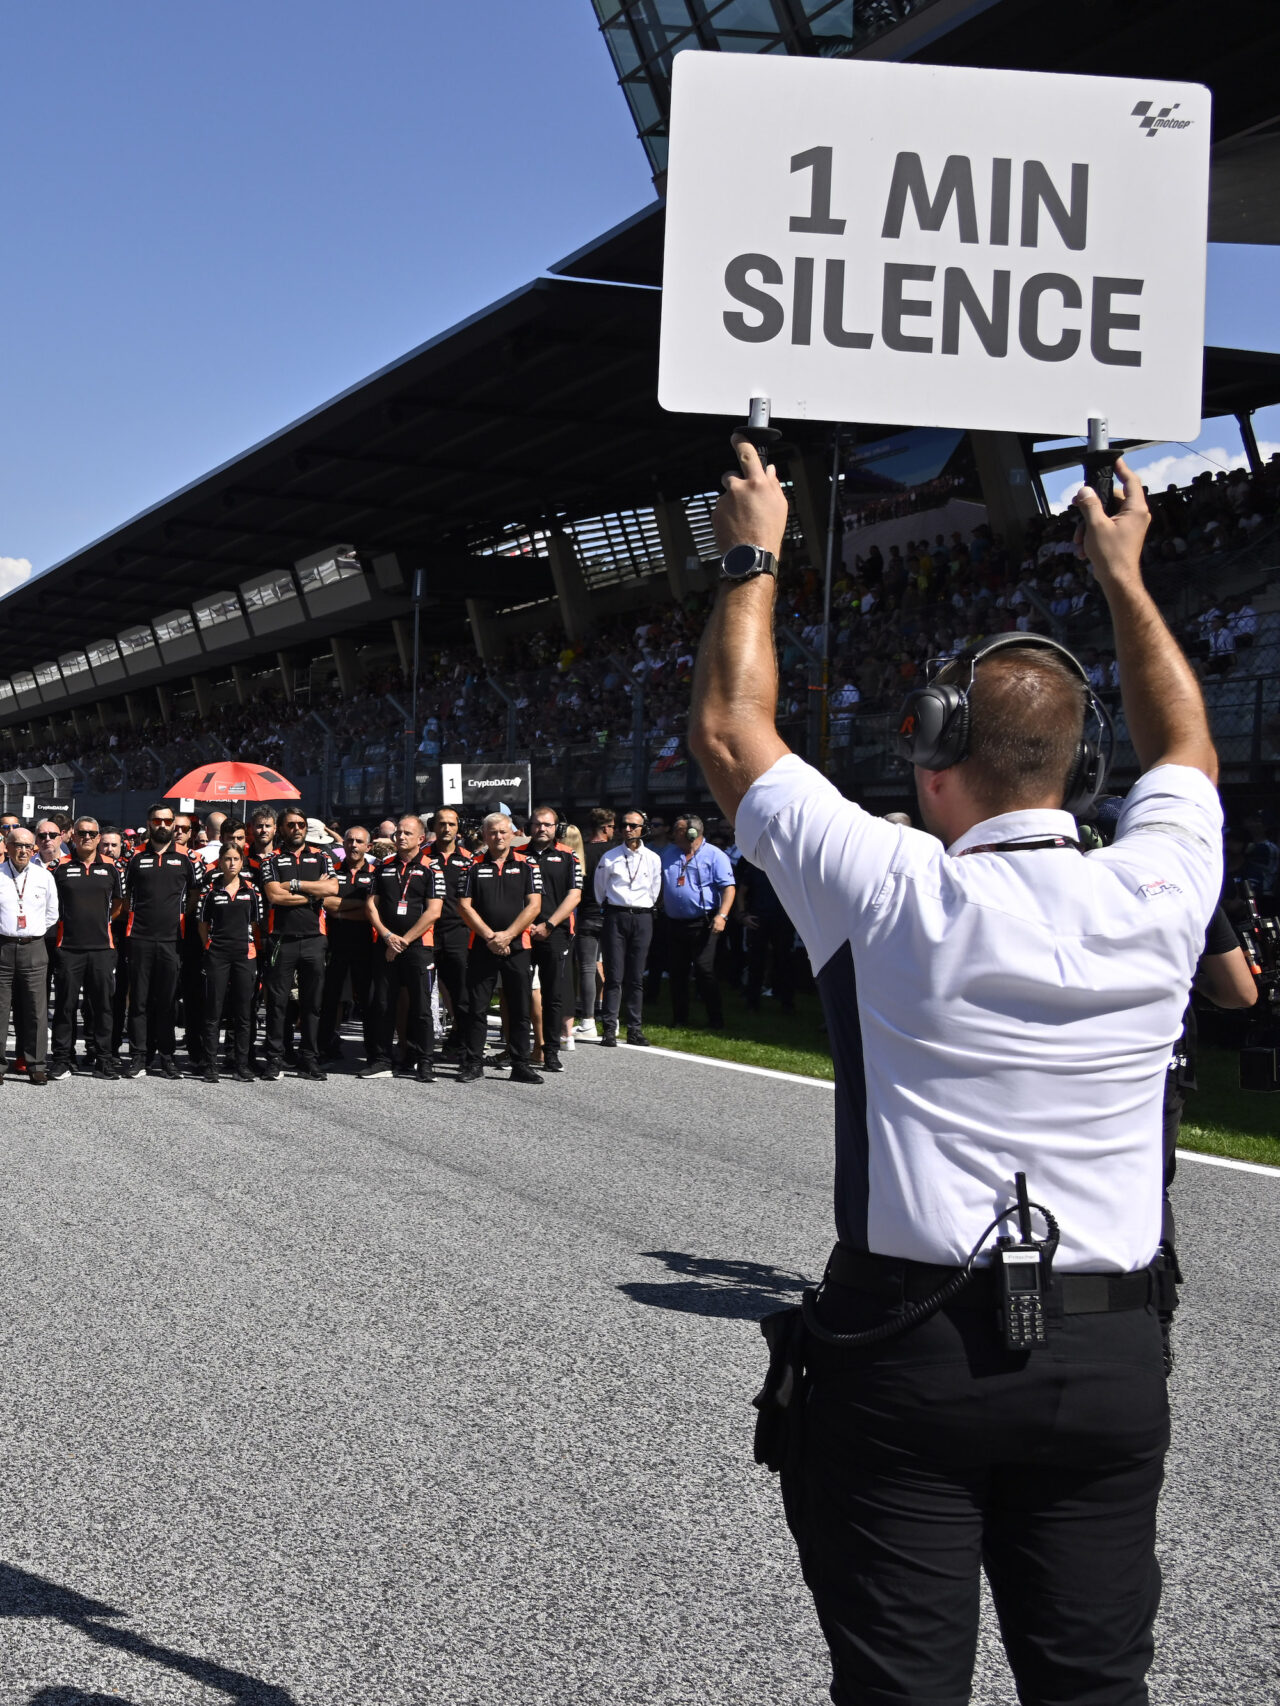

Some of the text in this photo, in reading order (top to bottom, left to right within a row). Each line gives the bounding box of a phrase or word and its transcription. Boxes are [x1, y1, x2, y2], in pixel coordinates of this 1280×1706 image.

[789, 146, 1090, 251] 1 MIN
[722, 252, 1145, 367] SILENCE
[449, 778, 516, 789] 1 CryptoDATA
